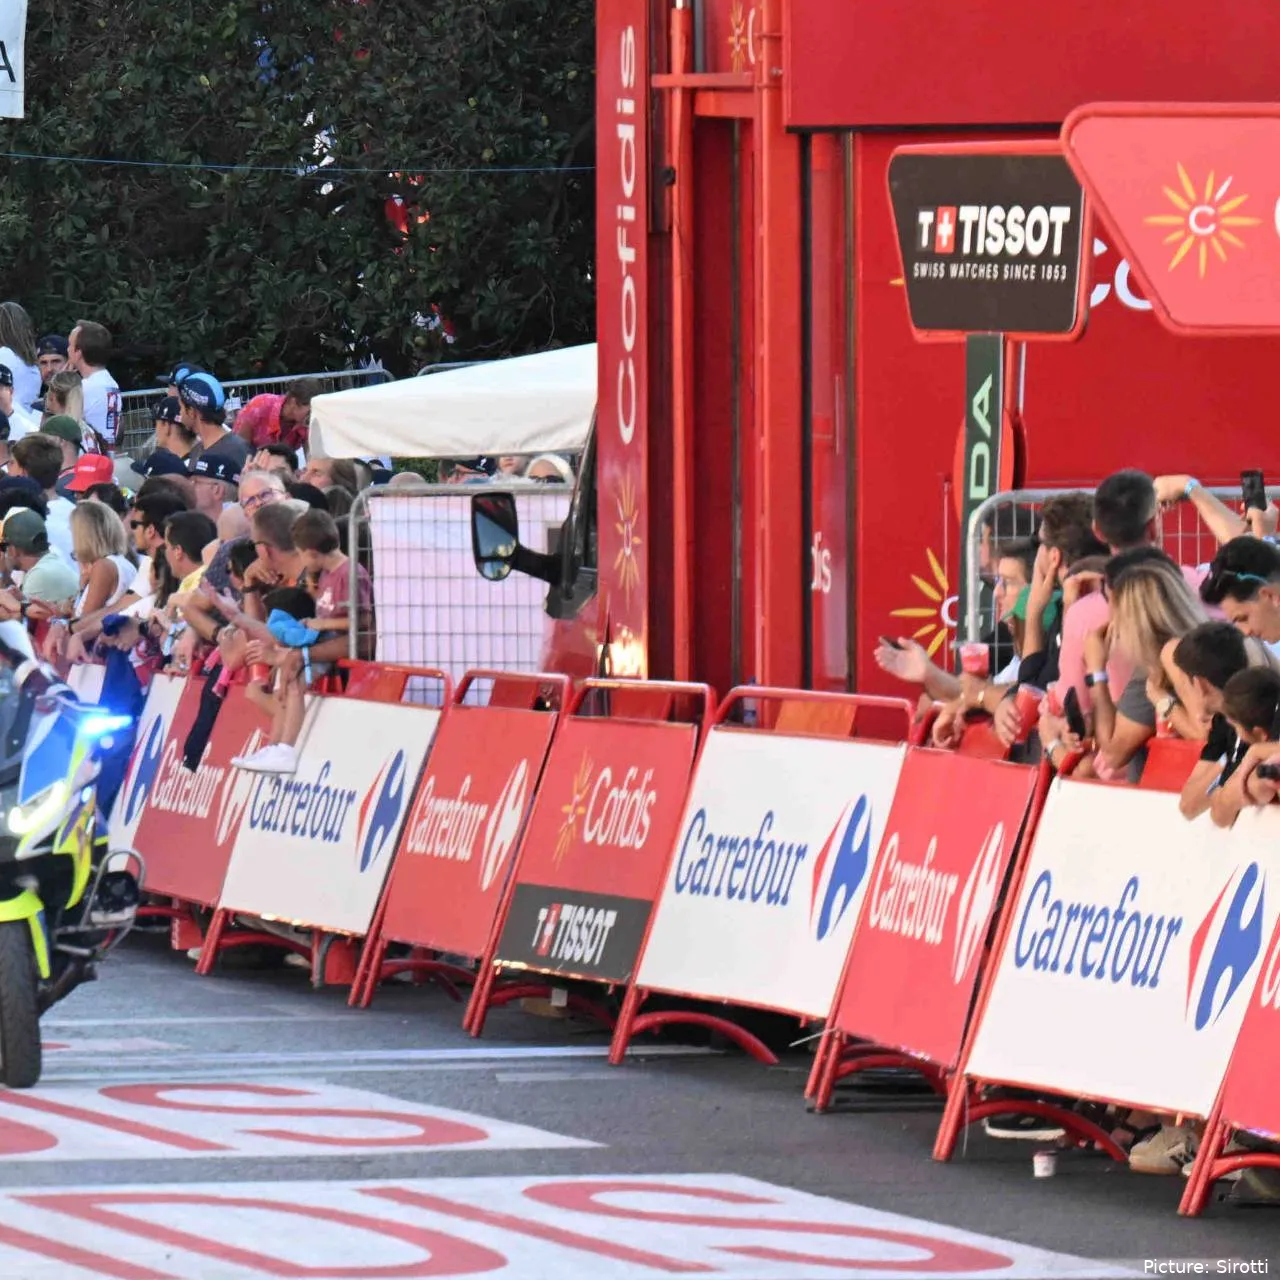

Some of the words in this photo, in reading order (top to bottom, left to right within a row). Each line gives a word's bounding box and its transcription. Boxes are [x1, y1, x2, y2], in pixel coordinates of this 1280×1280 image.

[616, 24, 637, 445] Cofidis
[914, 262, 945, 280] SWISS
[949, 262, 1000, 281] WATCHES
[1003, 263, 1036, 281] SINCE
[1041, 264, 1068, 281] 1853
[959, 205, 1071, 256] TISSOT
[248, 759, 357, 843] Carrefour
[406, 774, 489, 862] Carrefour
[582, 765, 657, 851] Cofidis
[673, 806, 809, 907] Carrefour
[868, 831, 960, 946] Carrefour
[551, 903, 619, 966] TISSOT
[1012, 867, 1183, 991] Carrefour
